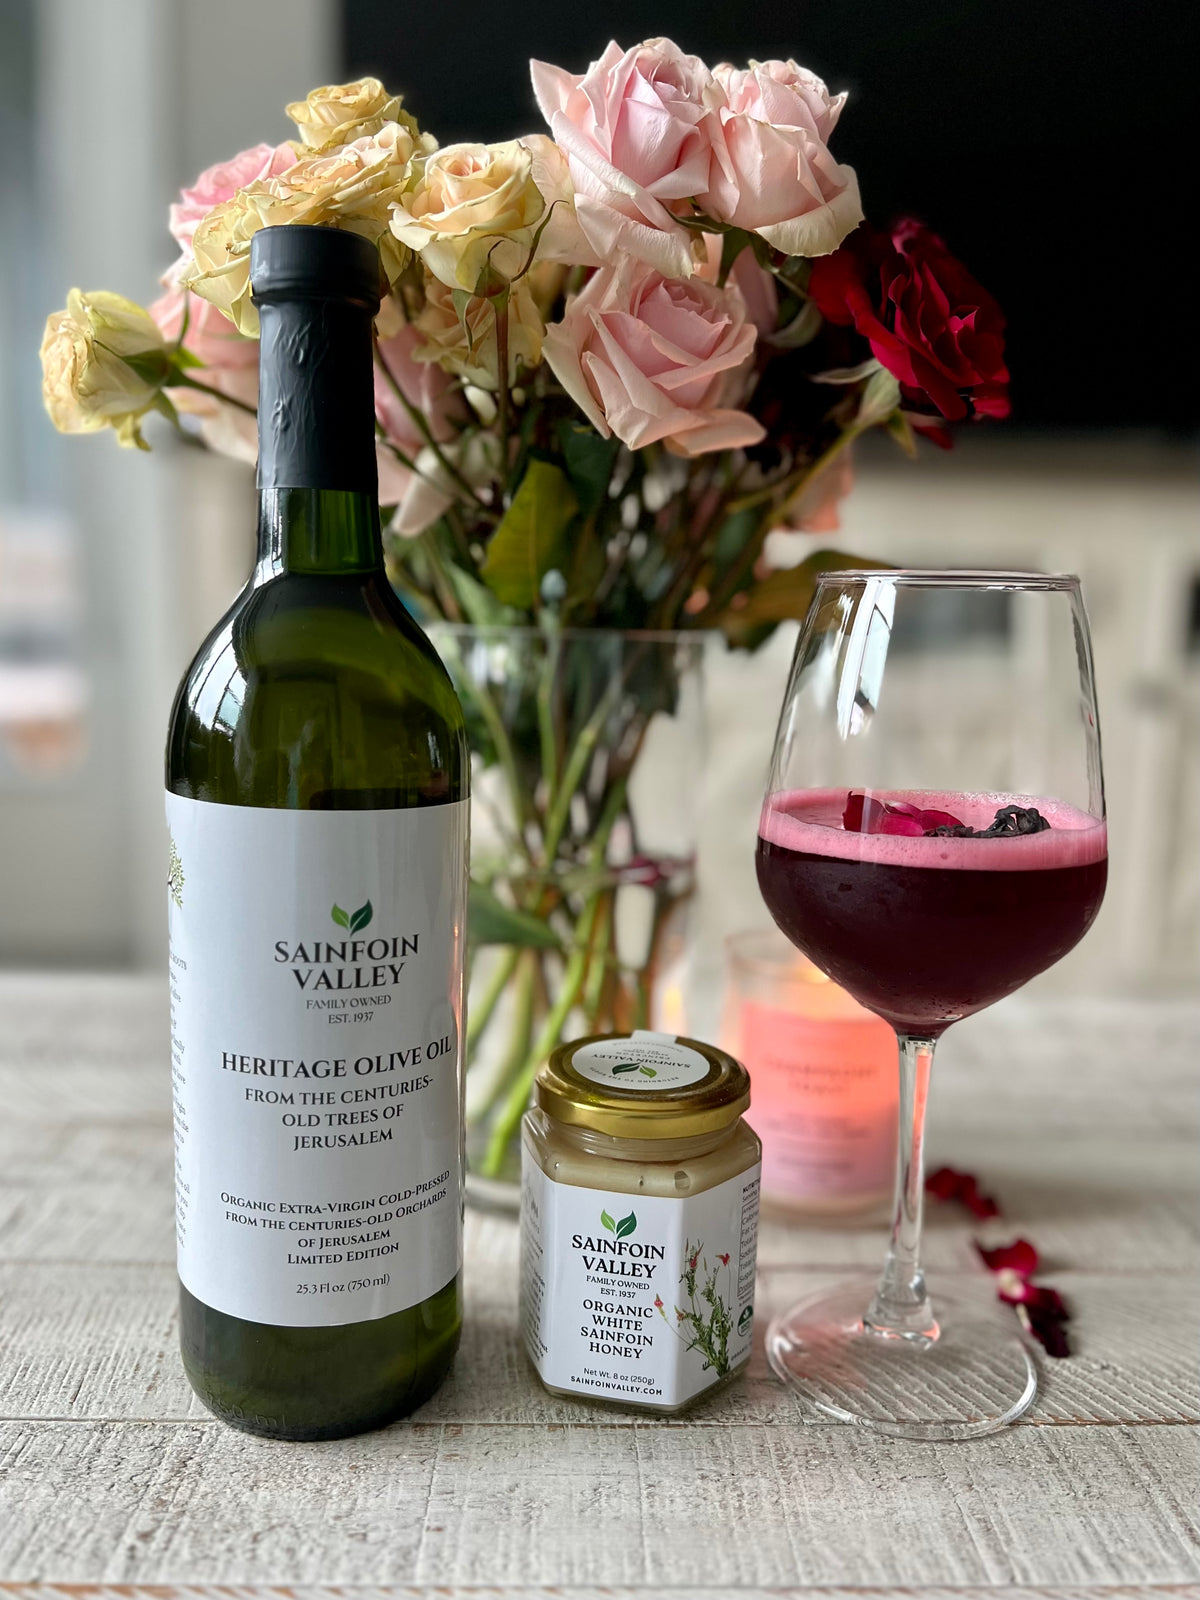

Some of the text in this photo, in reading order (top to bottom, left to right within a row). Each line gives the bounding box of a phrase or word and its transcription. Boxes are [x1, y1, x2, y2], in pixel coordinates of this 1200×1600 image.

[274, 934, 420, 964] SAINFOIN
[291, 962, 406, 991] VALLEY
[306, 994, 392, 1010] FAMILY OWNED
[328, 1011, 374, 1024] EST. 1937
[221, 1035, 452, 1079] HERITAGE OLIVE OIL
[590, 1053, 634, 1061] VALLEY
[636, 1058, 691, 1068] SAINFOIN
[245, 1074, 434, 1105] FROM THE CENTURIES-
[282, 1104, 405, 1127] OLD TREES OF
[293, 1128, 393, 1151] JERUSALEM
[220, 1169, 450, 1215] ORGANIC EXTRA-VIRGIN COLD-PRESSED
[225, 1188, 447, 1231] FROM THE CENTURIES-OLD ORCHARDS
[298, 1229, 391, 1250] OF JERUSALEM
[571, 1234, 666, 1260] SAINFOIN
[287, 1242, 400, 1265] LIMITED EDITION
[582, 1255, 657, 1279] VALLEY
[296, 1282, 318, 1295] 25.3
[347, 1277, 371, 1294] (750
[372, 1273, 391, 1289] ml)
[586, 1275, 650, 1291] FAMILY OWNED
[600, 1288, 636, 1299] EST. 1937
[582, 1299, 654, 1319] ORGANIC
[591, 1314, 643, 1332] WHITE
[580, 1326, 654, 1346] SAINFOIN
[589, 1341, 644, 1359] HONEY
[570, 1375, 663, 1396] SAINFOINVALLEY.COM
[583, 1367, 655, 1386] Net Wt. 8 oz (250g)
